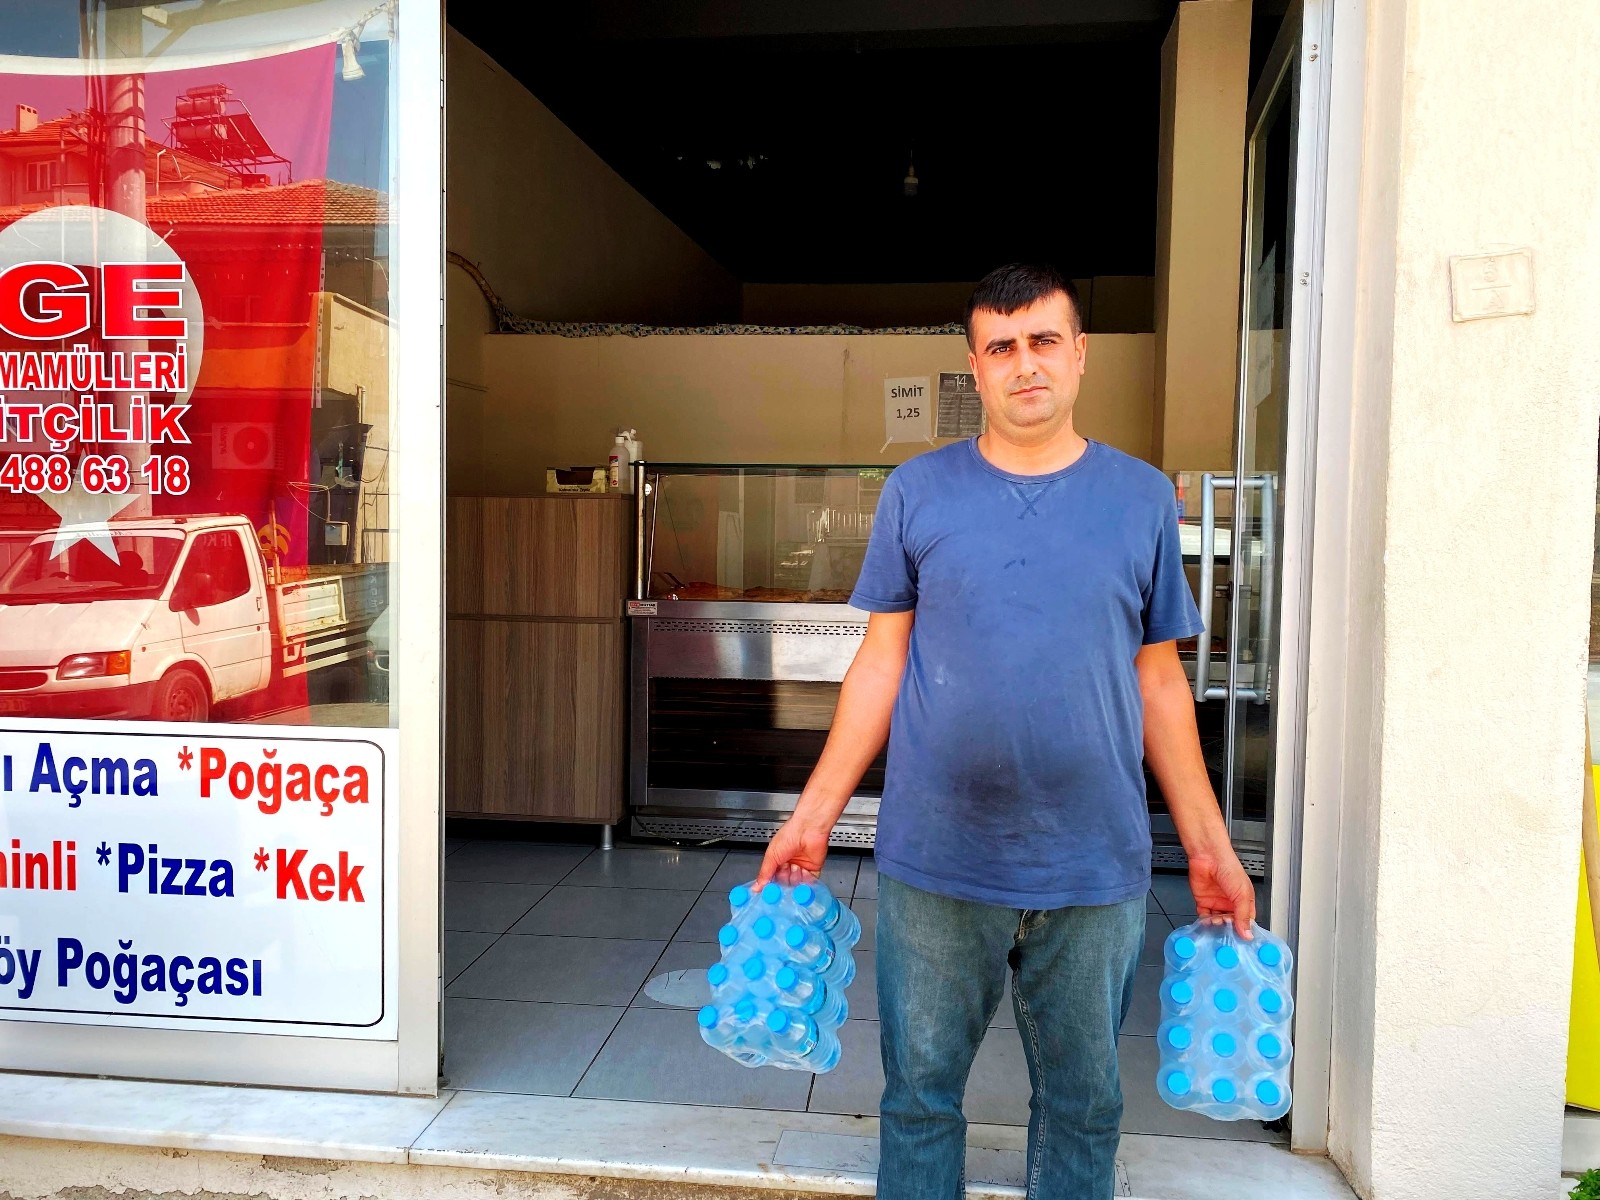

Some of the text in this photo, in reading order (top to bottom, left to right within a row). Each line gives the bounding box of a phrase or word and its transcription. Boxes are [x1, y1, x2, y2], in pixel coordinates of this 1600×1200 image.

[0, 260, 188, 341] GE
[890, 385, 924, 398] SİMİT
[954, 374, 968, 388] 14
[896, 407, 920, 420] 1,25
[0, 454, 190, 495] 488 63 18
[29, 743, 158, 808] Açma
[57, 938, 262, 1006] Poğaçası
